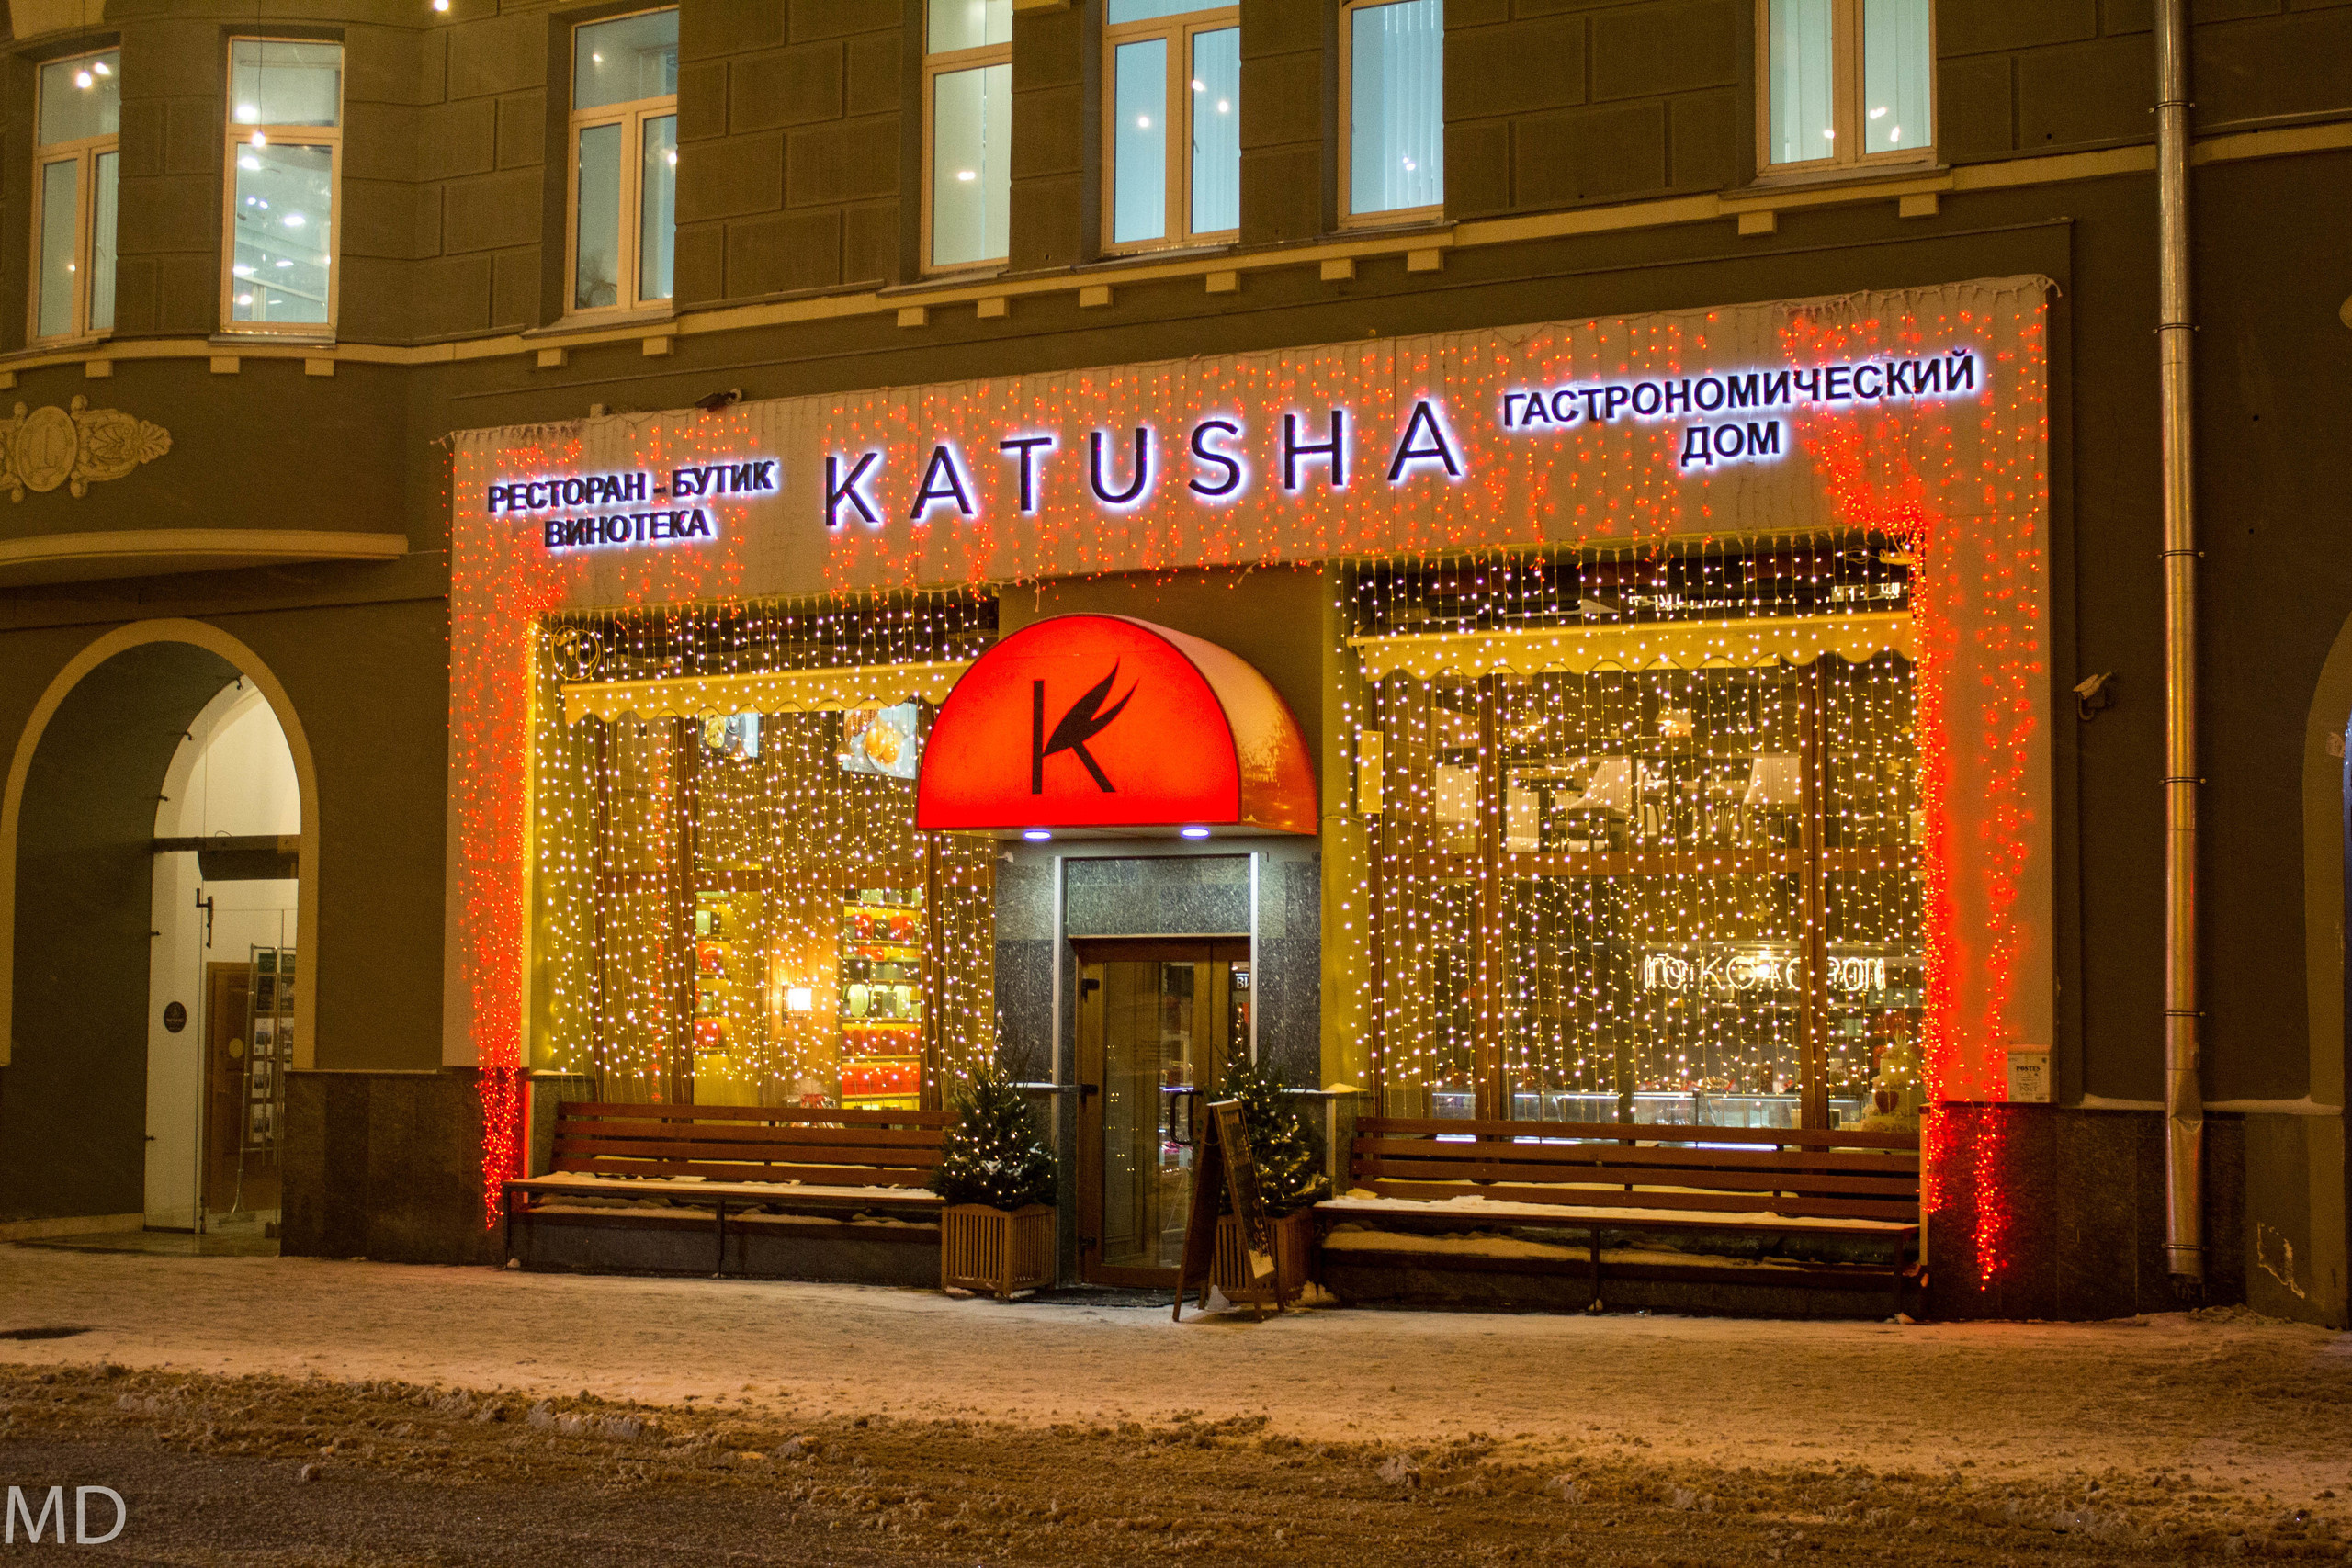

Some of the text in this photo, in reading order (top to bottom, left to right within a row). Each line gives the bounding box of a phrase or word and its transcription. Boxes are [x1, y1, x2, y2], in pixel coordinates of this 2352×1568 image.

[1503, 349, 1974, 427] ГАСТРОНОМИЧЕСКИЙ
[825, 400, 1462, 526] KATUSHA
[1680, 421, 1781, 467] ДОМ
[487, 472, 647, 513] РЕСТОРАН
[672, 459, 777, 498] БУТИК
[544, 508, 711, 548] ВИНОТЕКА
